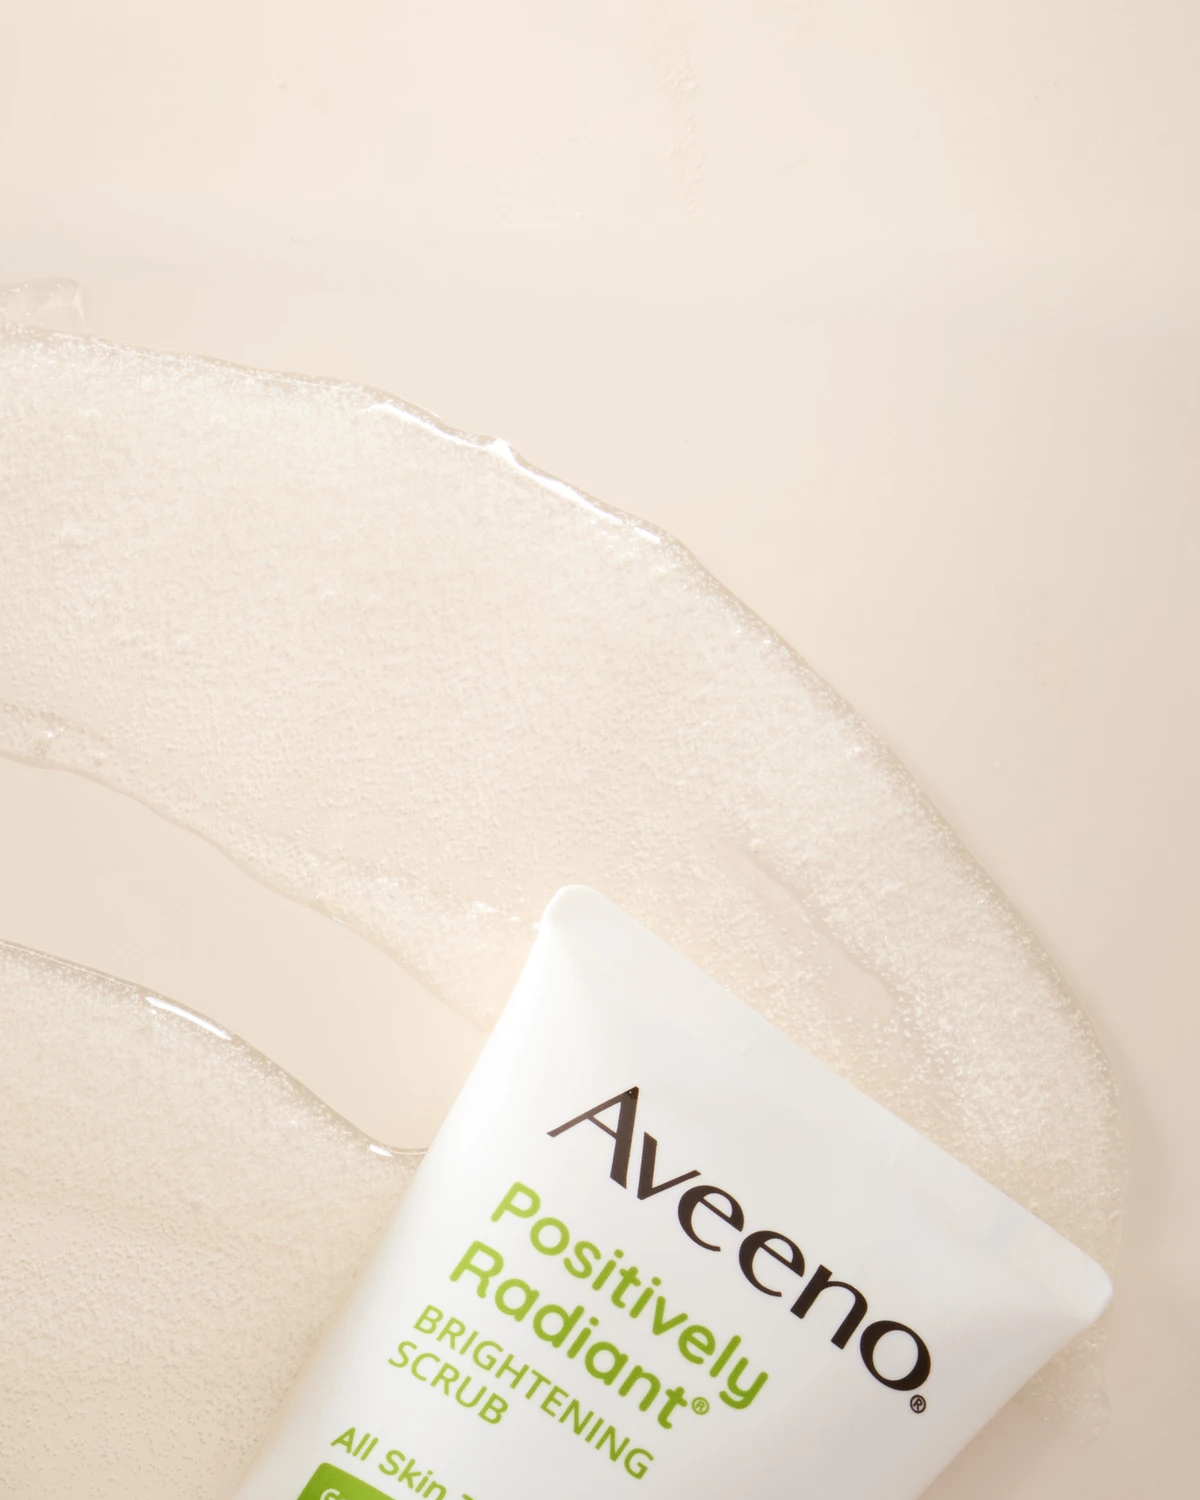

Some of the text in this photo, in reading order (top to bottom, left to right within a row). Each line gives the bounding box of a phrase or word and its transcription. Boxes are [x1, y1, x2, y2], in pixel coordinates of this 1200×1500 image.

[490, 1181, 768, 1410] Positively
[331, 1426, 378, 1461] All
[389, 1341, 509, 1426] SCRUB
[413, 1305, 654, 1480] BRIGHTENING
